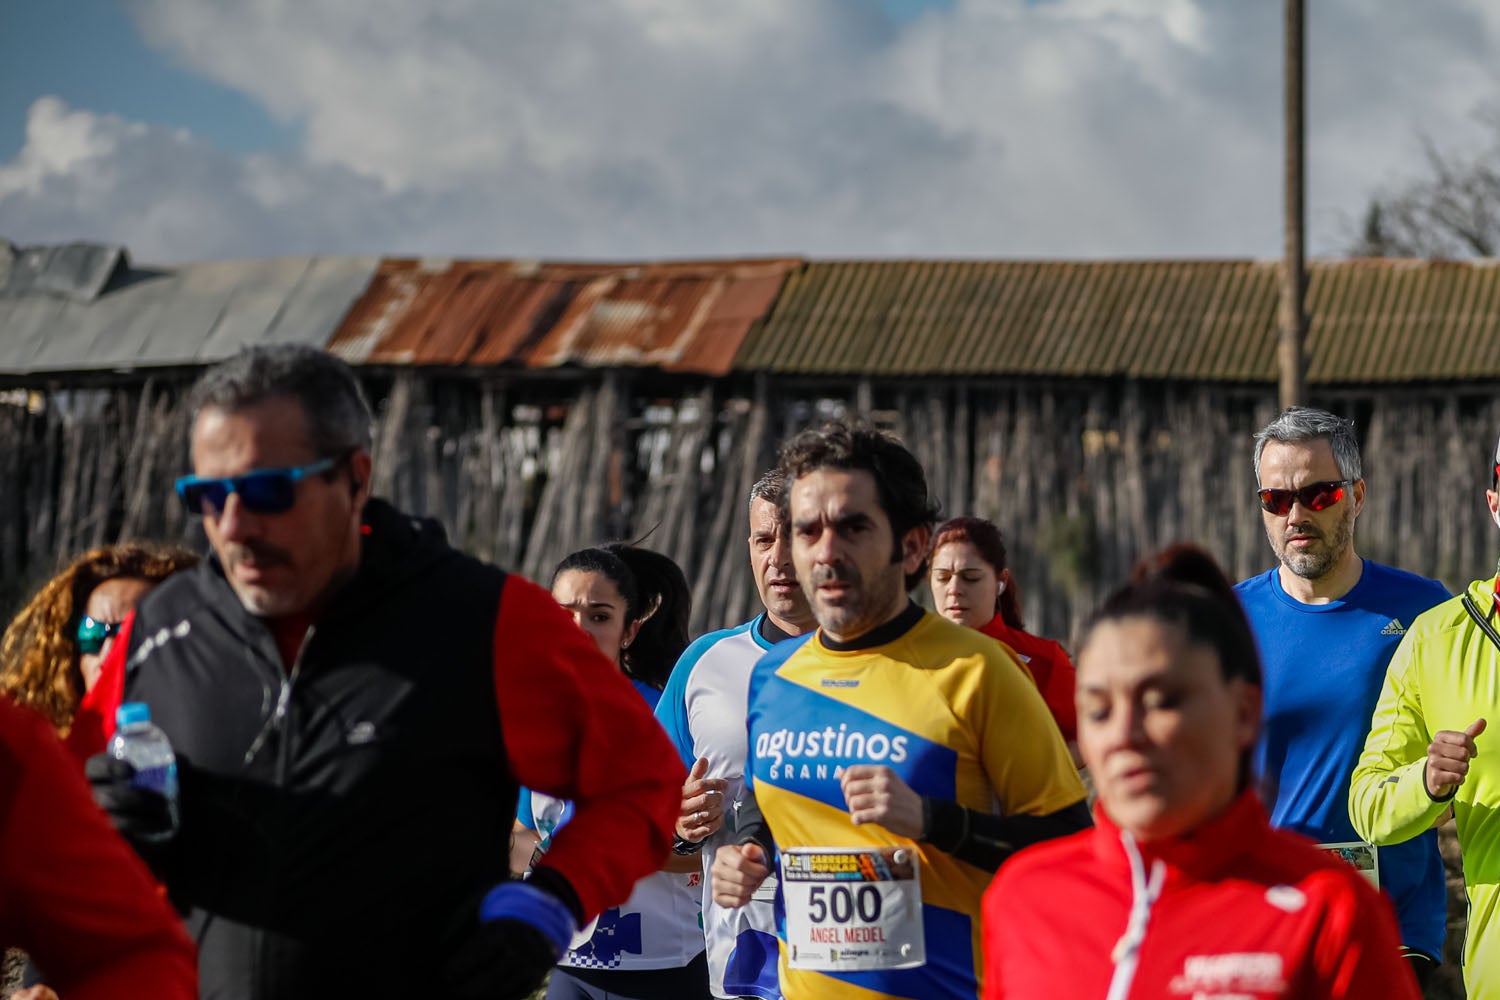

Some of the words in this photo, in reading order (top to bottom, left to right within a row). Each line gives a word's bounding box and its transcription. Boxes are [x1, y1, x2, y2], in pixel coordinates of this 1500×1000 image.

[756, 723, 908, 769] agustinos
[810, 855, 857, 864] CARRERA
[811, 863, 858, 872] POPULAR
[808, 884, 883, 924] 500
[809, 927, 842, 944] ANGEL
[843, 926, 887, 943] MEDEL
